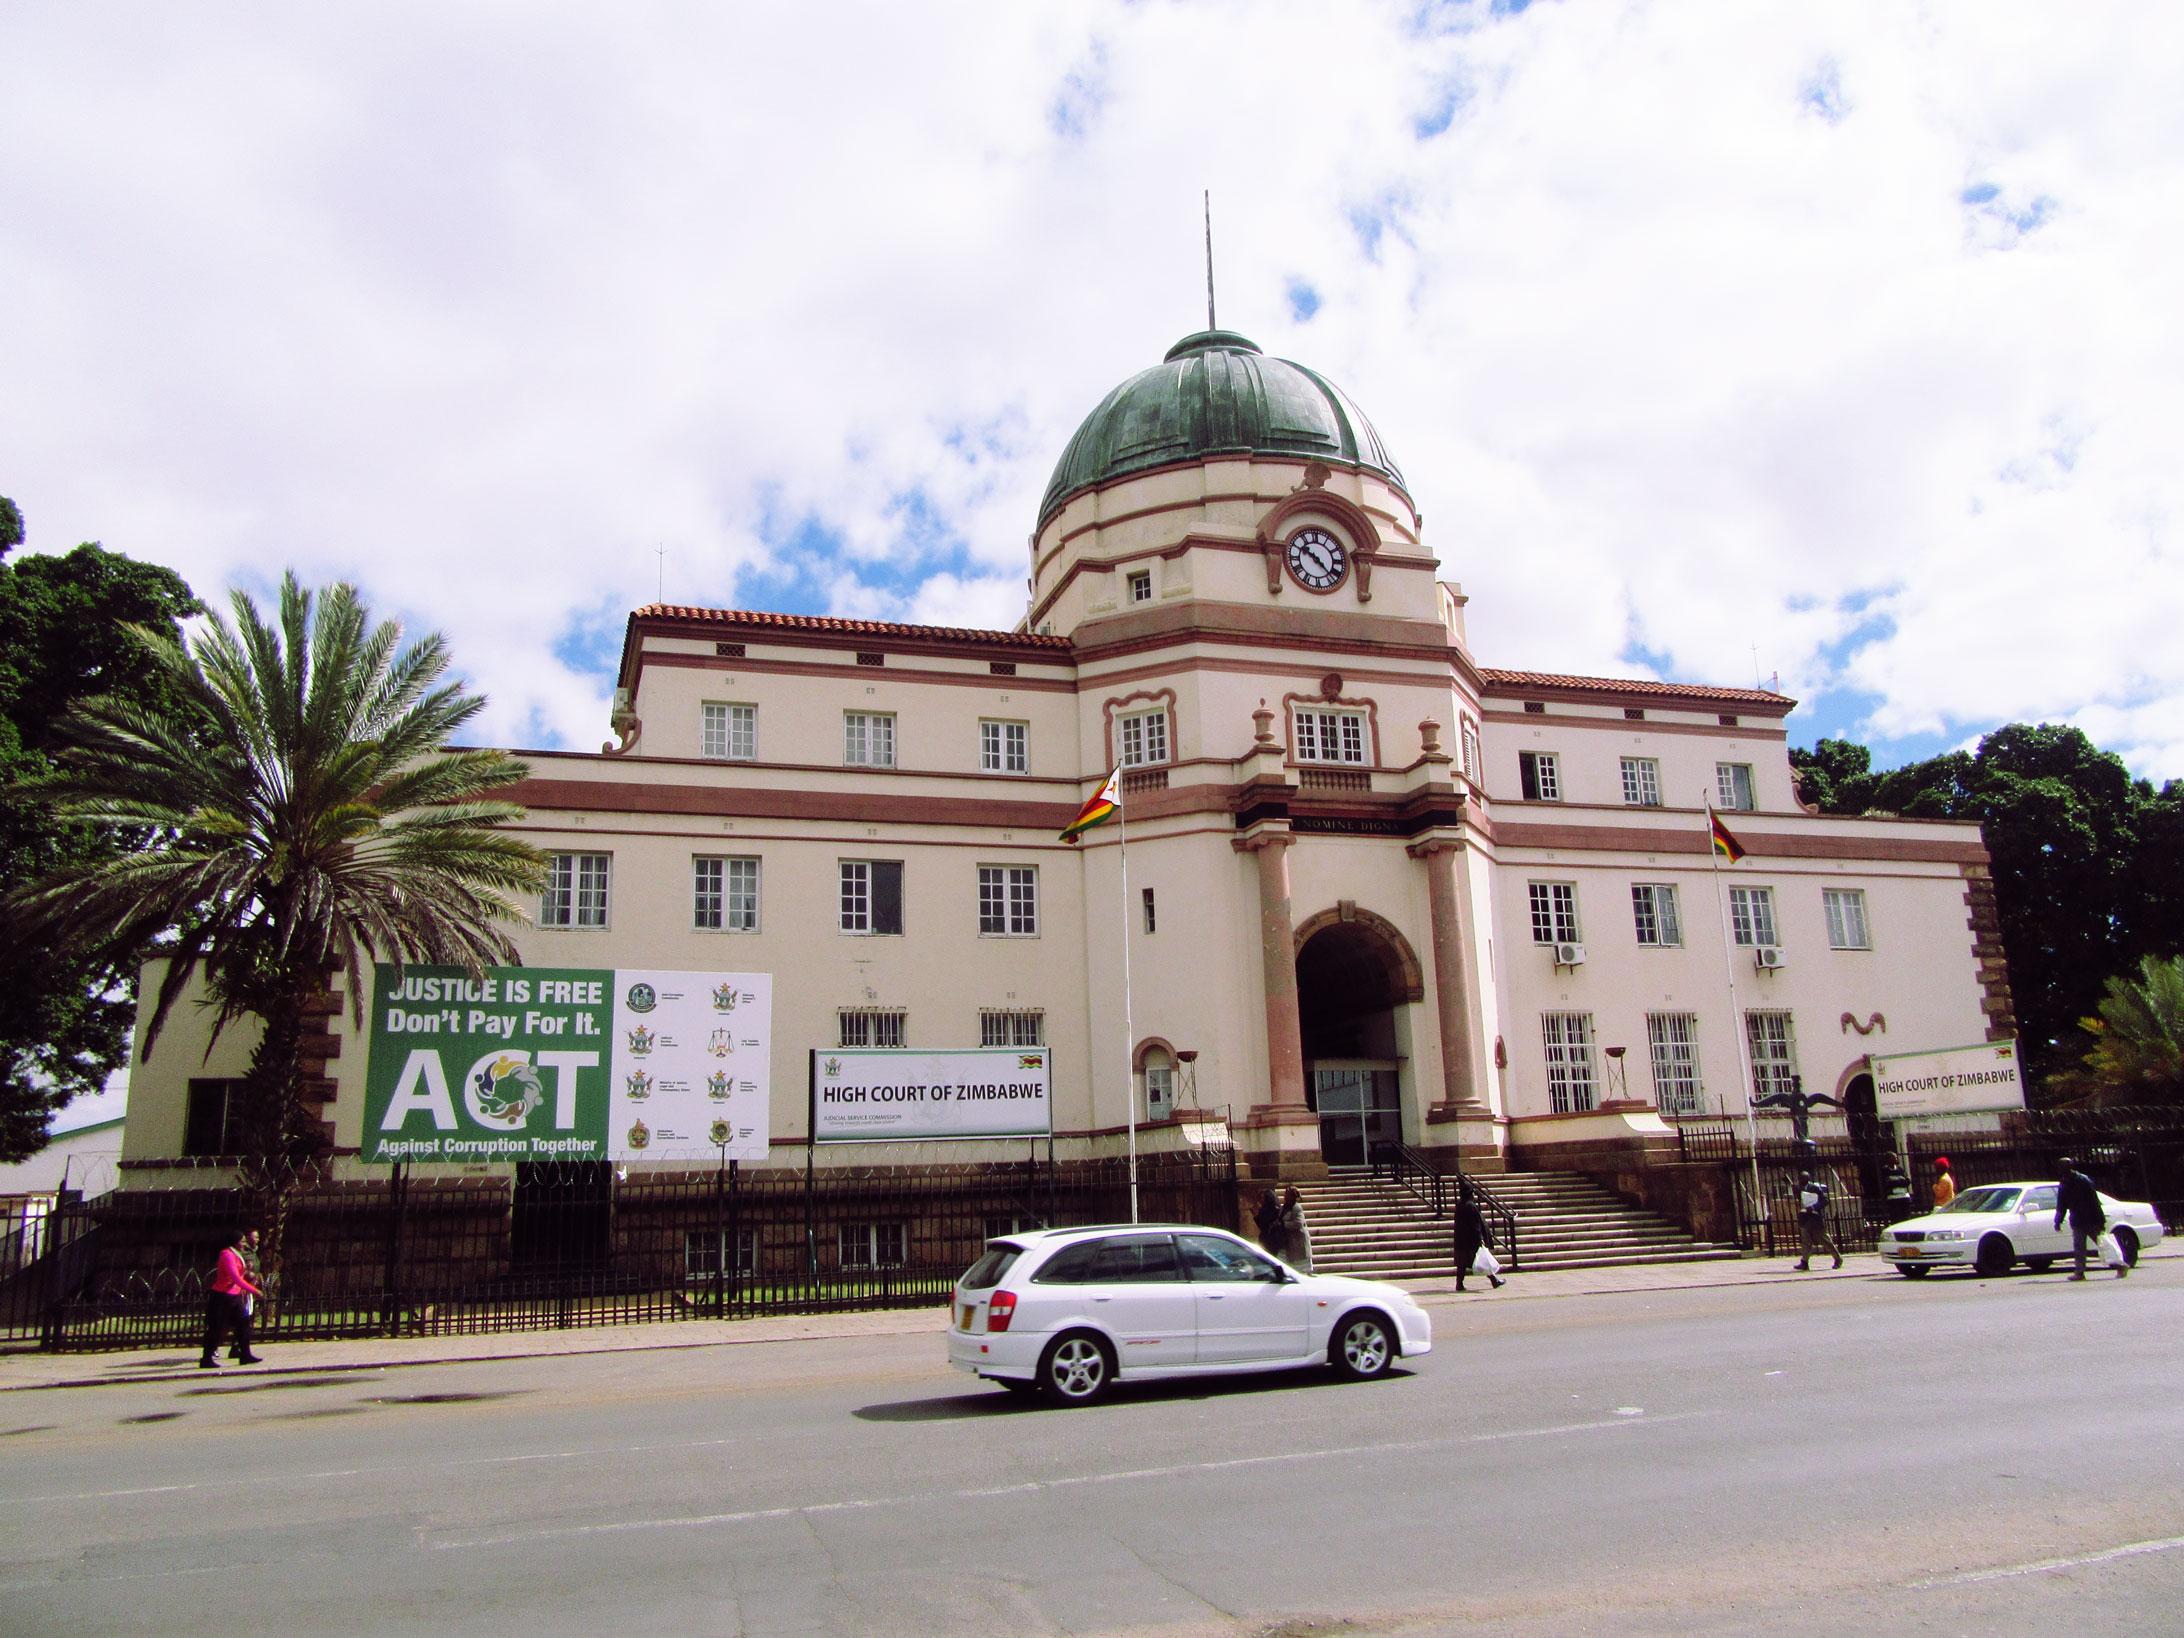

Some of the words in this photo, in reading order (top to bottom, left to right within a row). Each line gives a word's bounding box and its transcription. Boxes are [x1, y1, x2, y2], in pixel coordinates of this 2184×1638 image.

[388, 977, 498, 1003] JUSTICE
[505, 979, 530, 1003] IS
[539, 980, 603, 1004] FREE
[387, 1008, 461, 1033] Don't
[468, 1009, 517, 1039] Pay
[525, 1011, 568, 1034] For
[575, 1012, 601, 1035] It.
[380, 1049, 600, 1131] ACT
[823, 1086, 866, 1103] HIGH
[871, 1085, 926, 1102] COURT
[930, 1085, 952, 1101] OF
[956, 1083, 1043, 1101] ZIMBABWE
[1878, 1082, 1904, 1094] HIGH
[1906, 1077, 1938, 1092] COURT
[1941, 1076, 1955, 1089] OF
[1958, 1069, 2015, 1087] ZIMBABWE
[378, 1137, 440, 1157] Against
[444, 1138, 527, 1154] Corruption
[531, 1138, 597, 1156] Together
